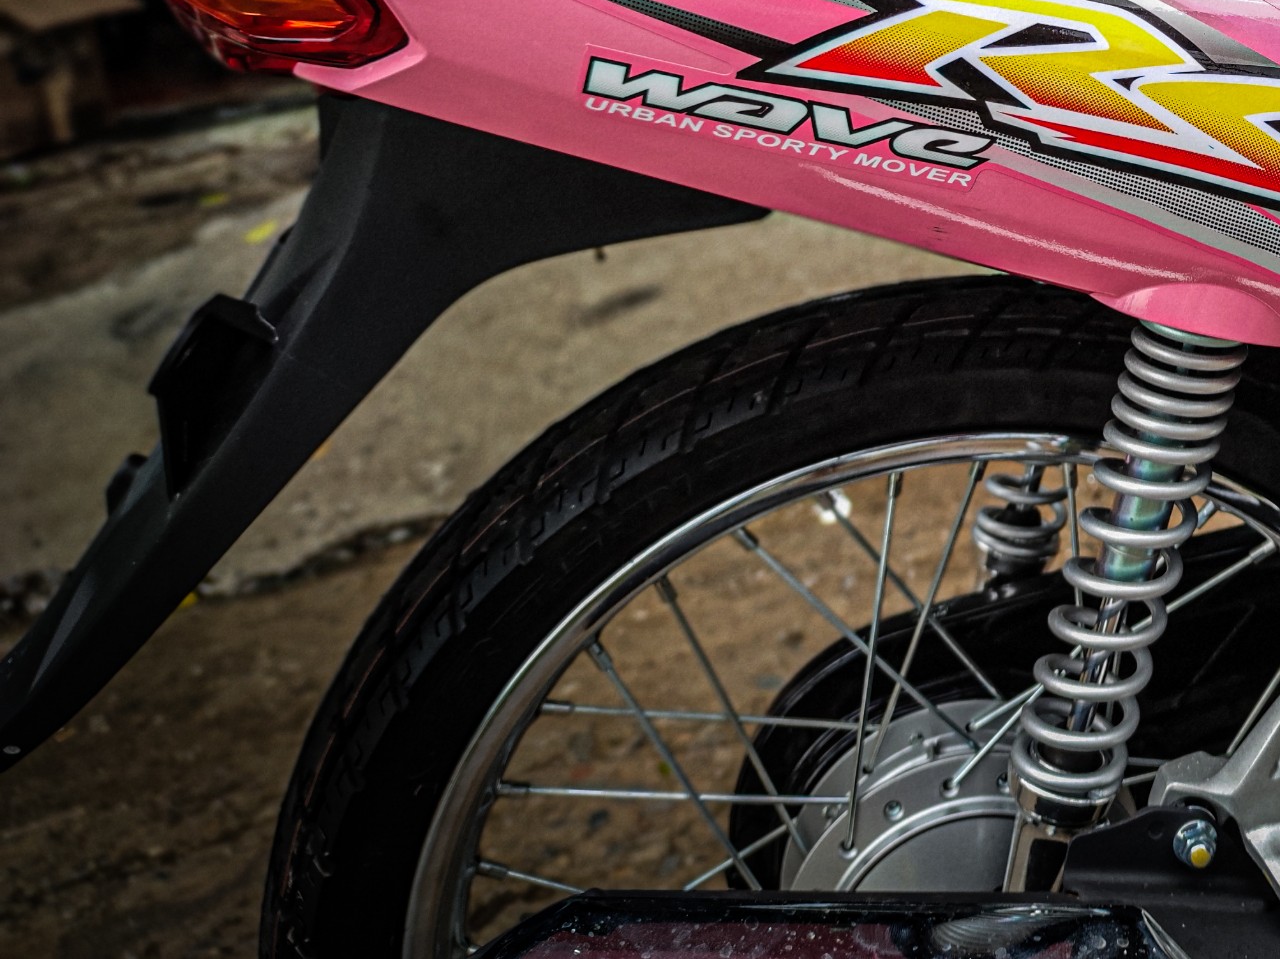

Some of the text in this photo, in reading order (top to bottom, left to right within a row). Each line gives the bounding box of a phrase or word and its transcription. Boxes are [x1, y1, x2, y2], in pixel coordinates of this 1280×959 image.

[585, 96, 973, 188] URBAN SPORTY MOVER
